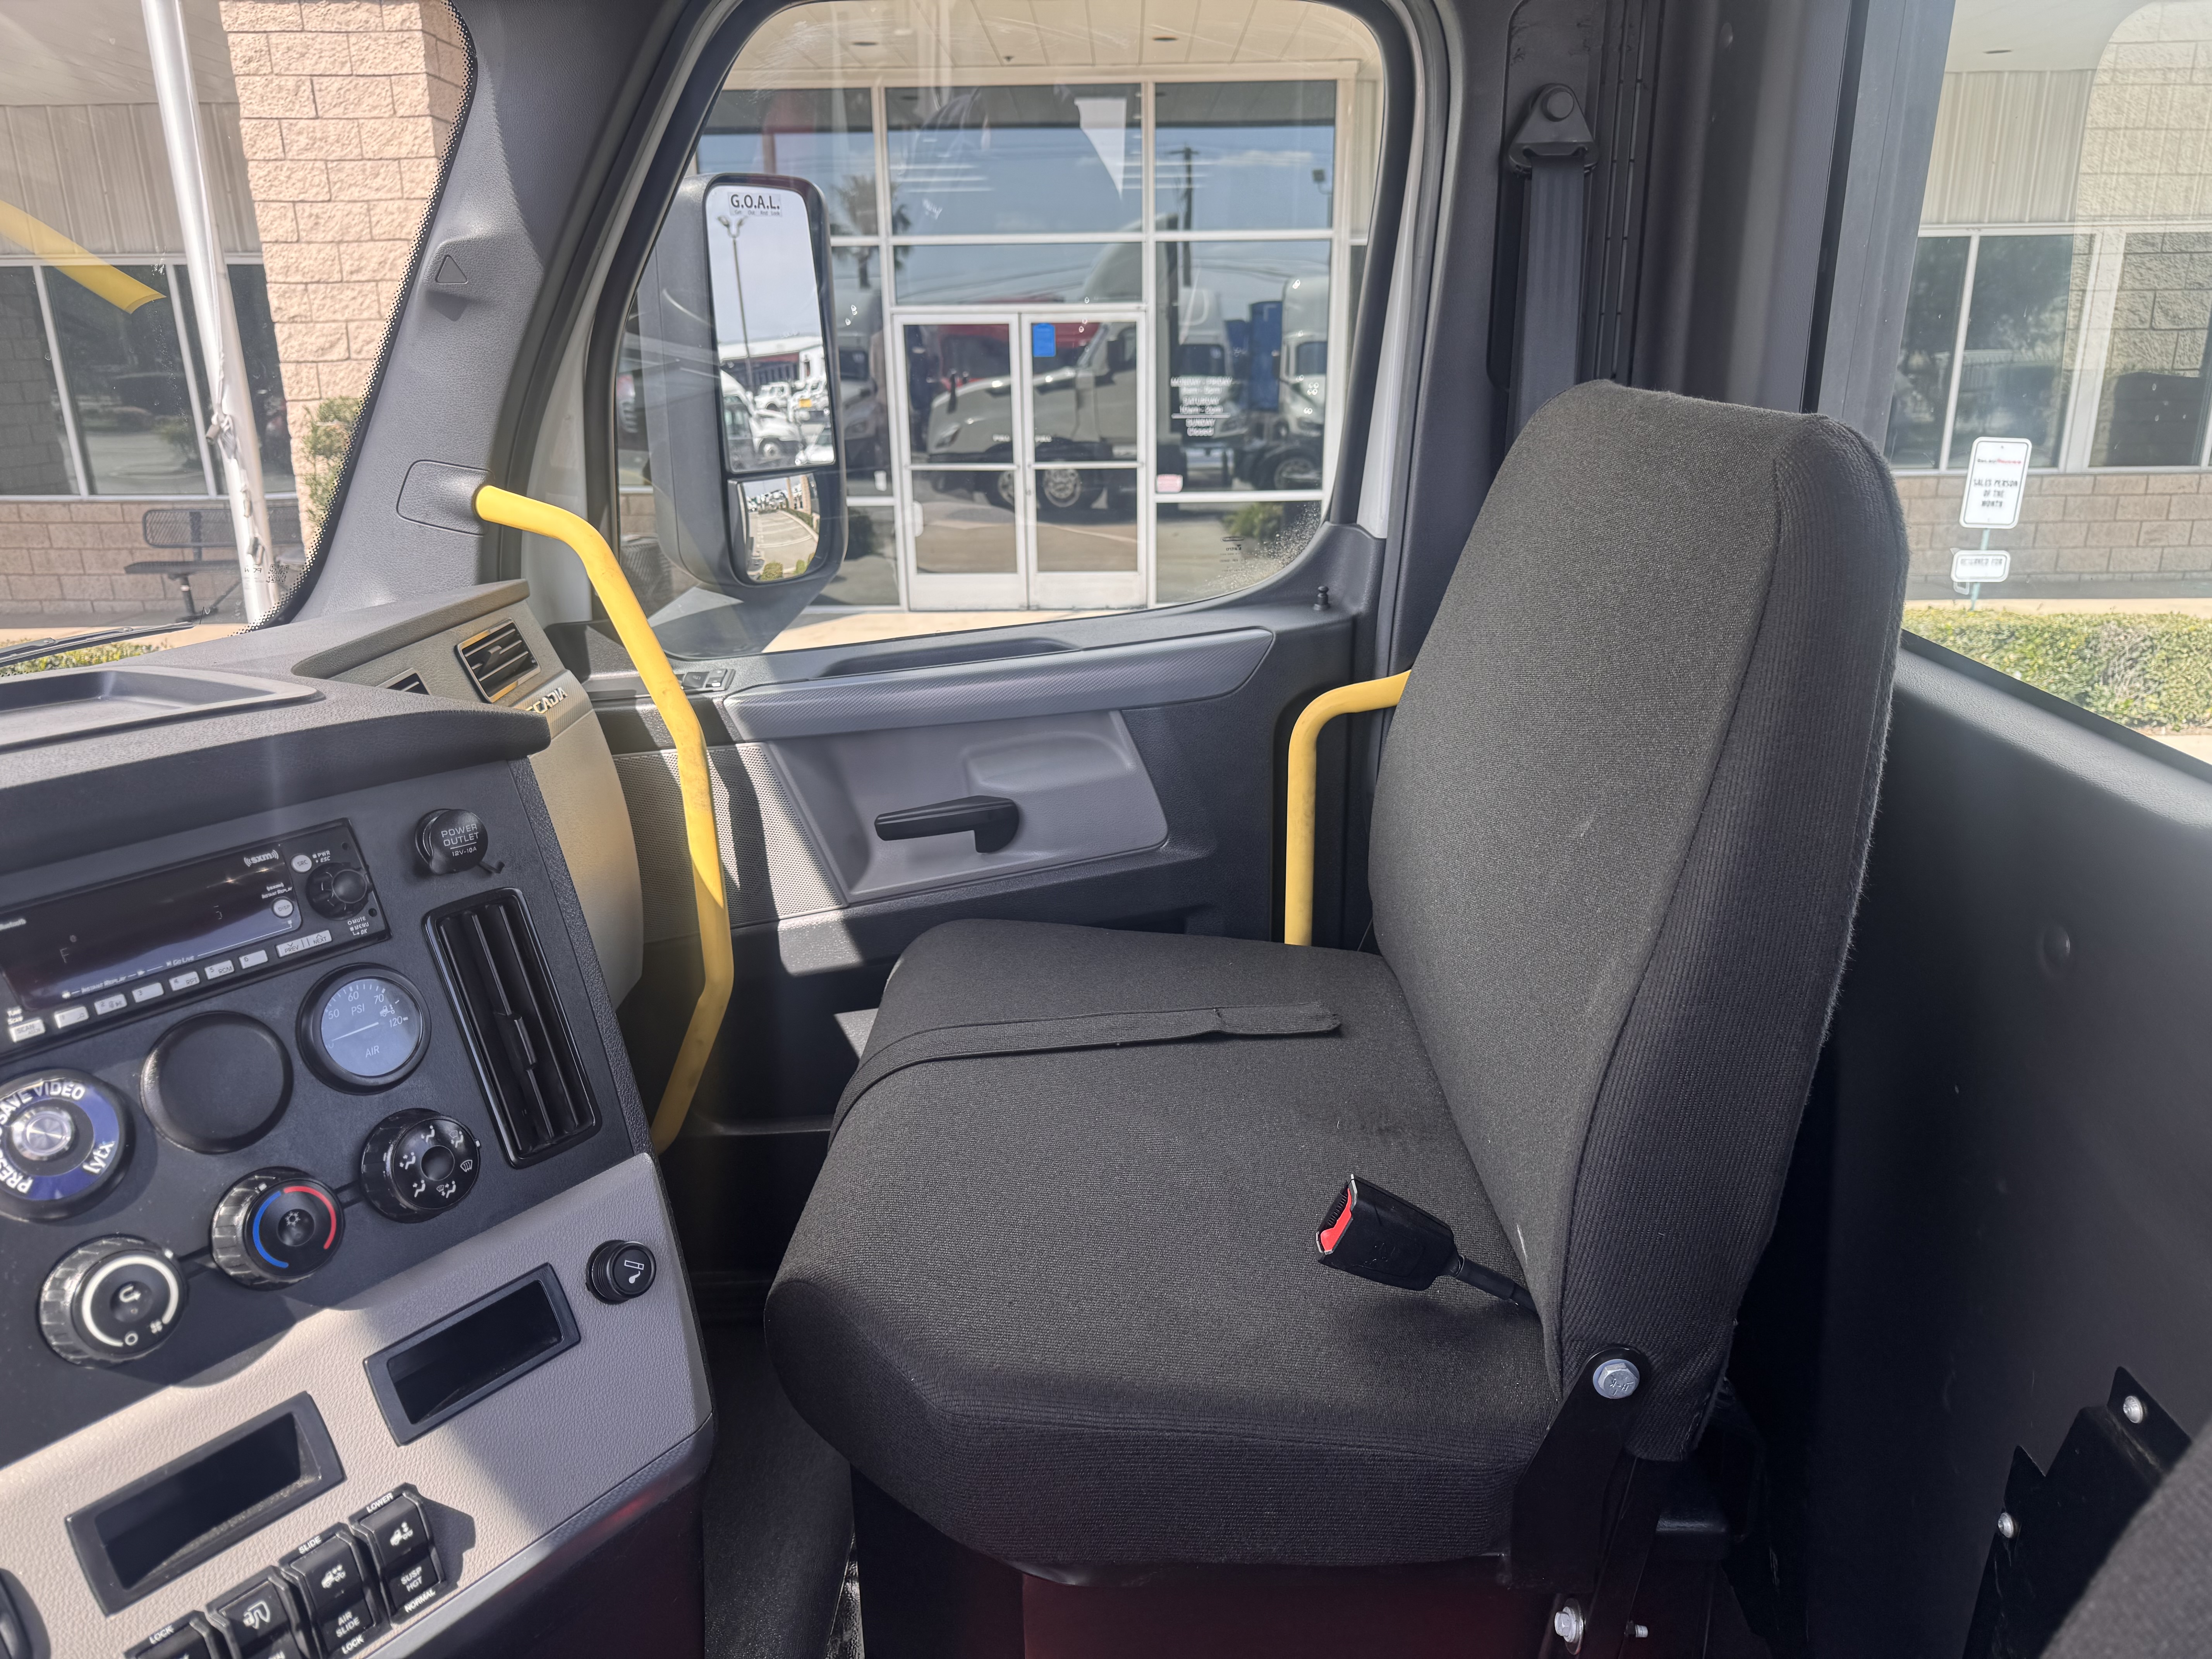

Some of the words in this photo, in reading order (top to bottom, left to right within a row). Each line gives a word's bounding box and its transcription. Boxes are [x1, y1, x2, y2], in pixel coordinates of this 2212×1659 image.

[731, 194, 780, 209] G.O.A.L.
[441, 824, 477, 838] POWER
[443, 832, 479, 846] OUTLET
[452, 847, 477, 857] 12V-10A
[313, 936, 326, 945] NEXT
[285, 945, 299, 953] PREV
[348, 991, 359, 1001] 60
[374, 994, 384, 1004] 70
[328, 1009, 340, 1020] 50
[352, 1003, 365, 1016] PSI
[389, 1016, 403, 1027] 120
[17, 1024, 35, 1034] SCAN
[366, 1045, 380, 1058] AIR
[33, 1082, 86, 1101] VIDEO
[82, 1141, 115, 1174] lytx
[366, 1492, 393, 1513] LOWER
[298, 1535, 322, 1554] SLIDE
[401, 1566, 422, 1585] SUSP
[407, 1576, 423, 1592] HGT
[404, 1589, 436, 1613] NORMAL
[338, 1611, 353, 1626] AIR
[336, 1616, 360, 1638] SLIDE
[149, 1625, 175, 1645] LOCK
[342, 1634, 364, 1655] LOCK
